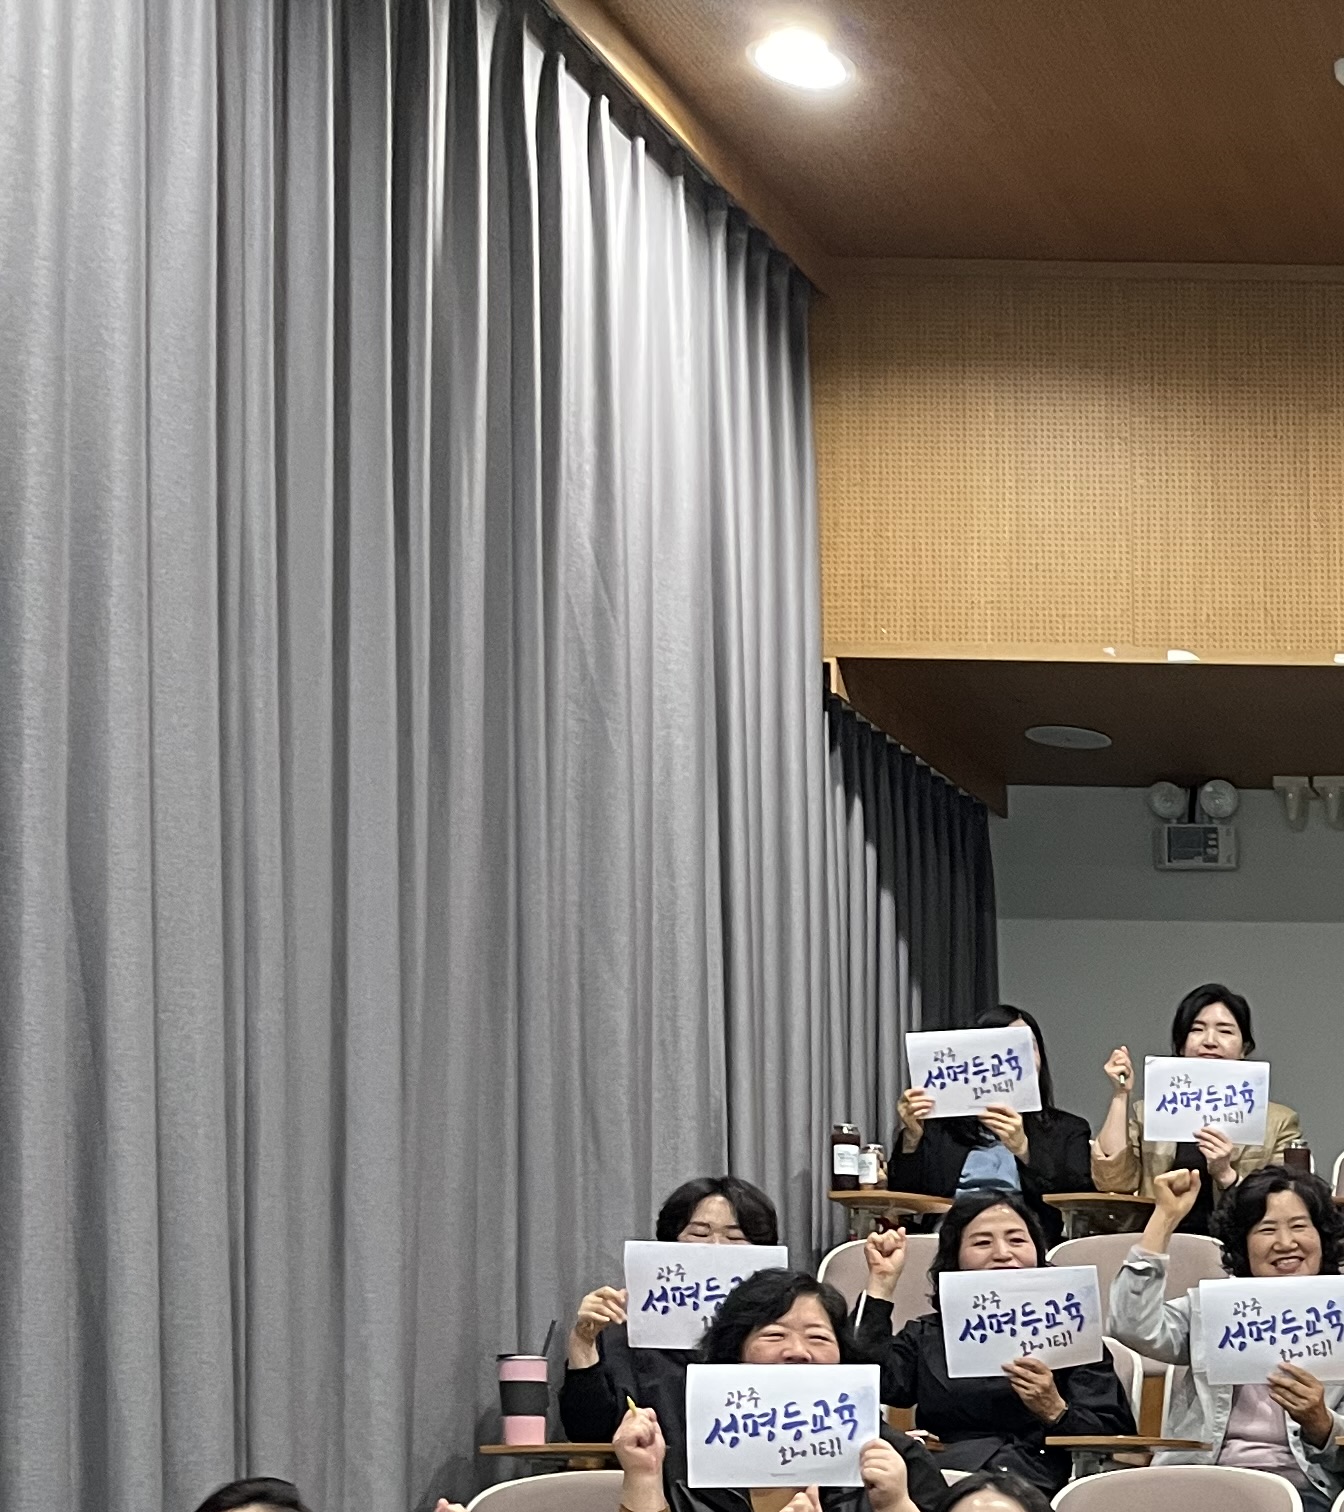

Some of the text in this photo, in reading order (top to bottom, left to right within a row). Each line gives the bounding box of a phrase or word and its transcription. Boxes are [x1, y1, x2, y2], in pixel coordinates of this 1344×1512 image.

[924, 1048, 1022, 1090] 성평등교육
[1156, 1081, 1254, 1114] 성평등교육
[959, 1293, 1084, 1343] 성평등교육
[973, 1291, 1001, 1309] 광주
[1233, 1297, 1260, 1317] 광주
[1219, 1300, 1344, 1351] 성평등교육
[724, 1387, 760, 1409] 광주
[705, 1393, 857, 1448] 성평등교육
